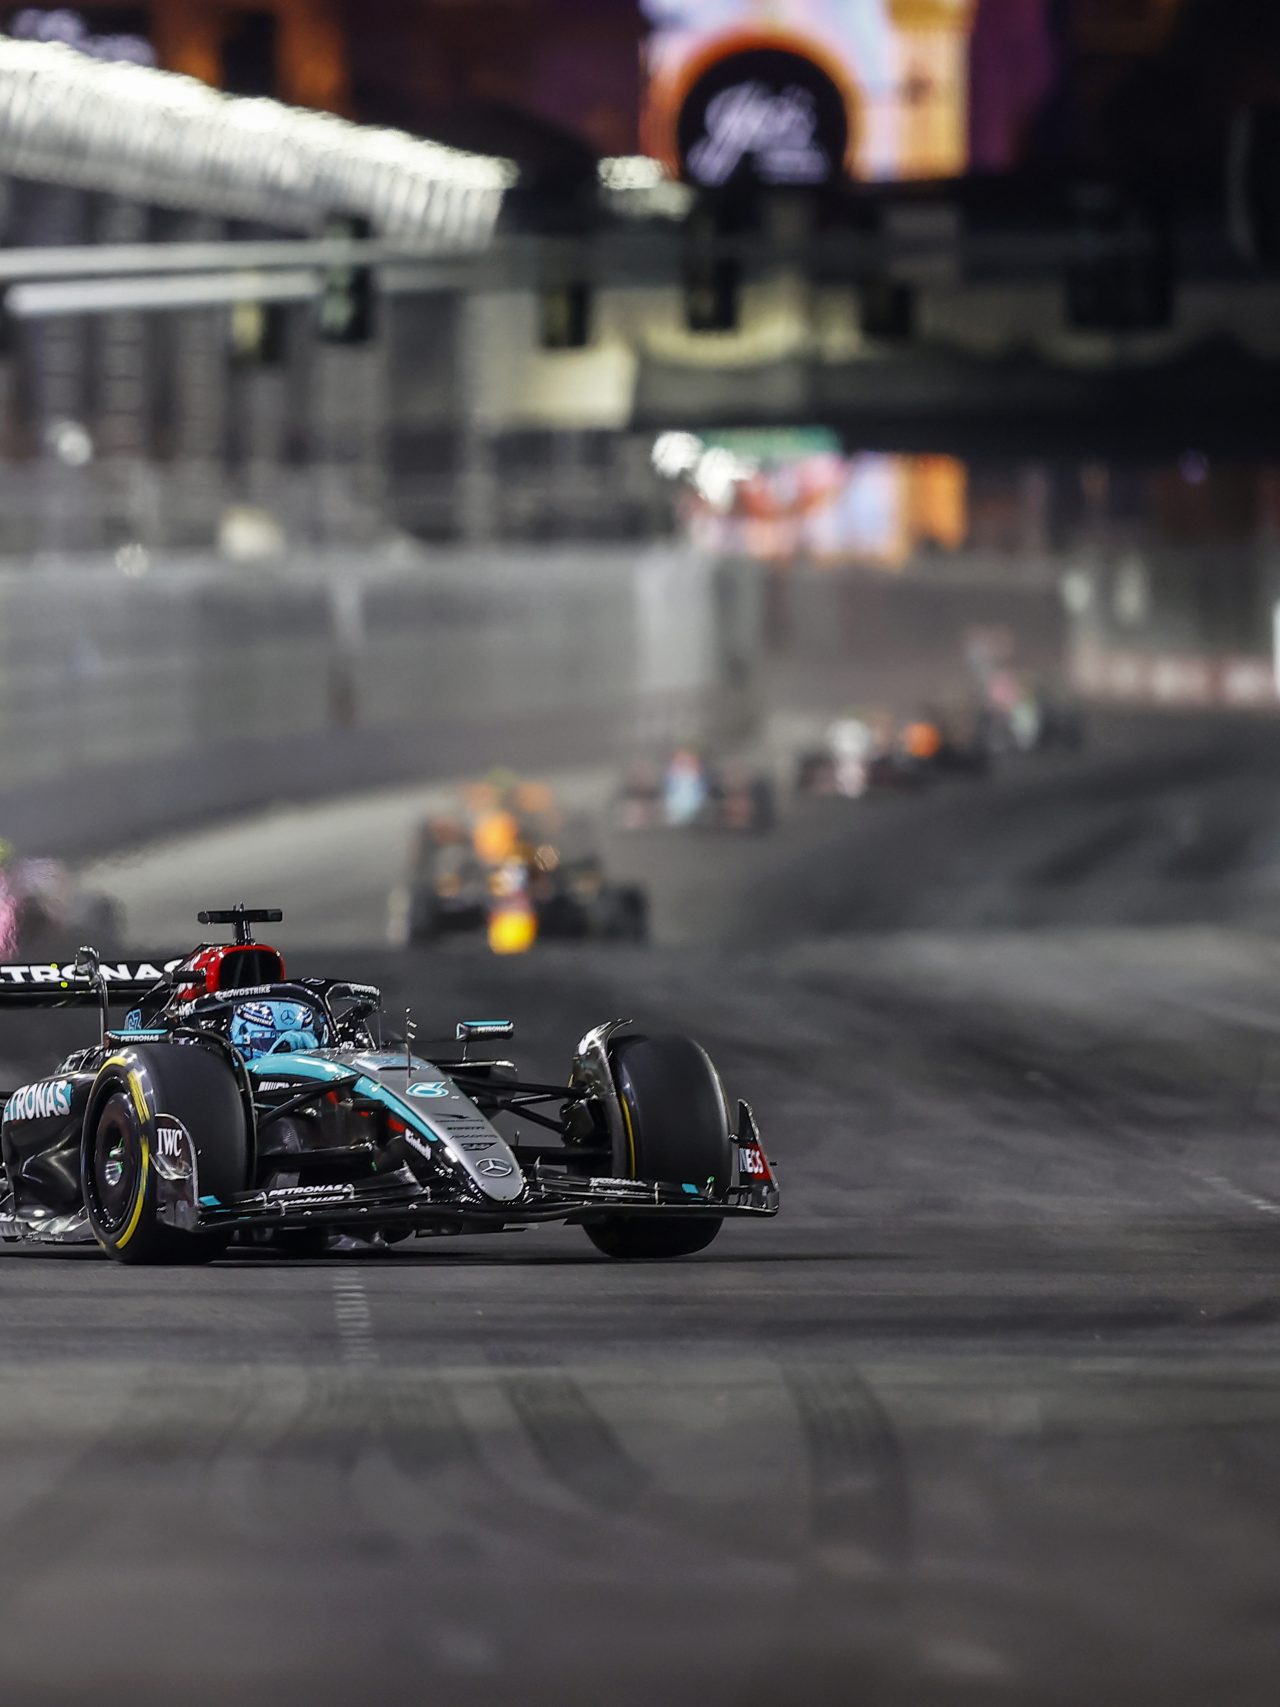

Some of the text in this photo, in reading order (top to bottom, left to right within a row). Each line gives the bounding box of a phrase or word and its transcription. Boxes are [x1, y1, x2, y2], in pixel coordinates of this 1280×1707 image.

[120, 1034, 160, 1042] PETRONAS
[157, 1128, 183, 1157] IWC
[269, 1184, 344, 1197] PETRONAS
